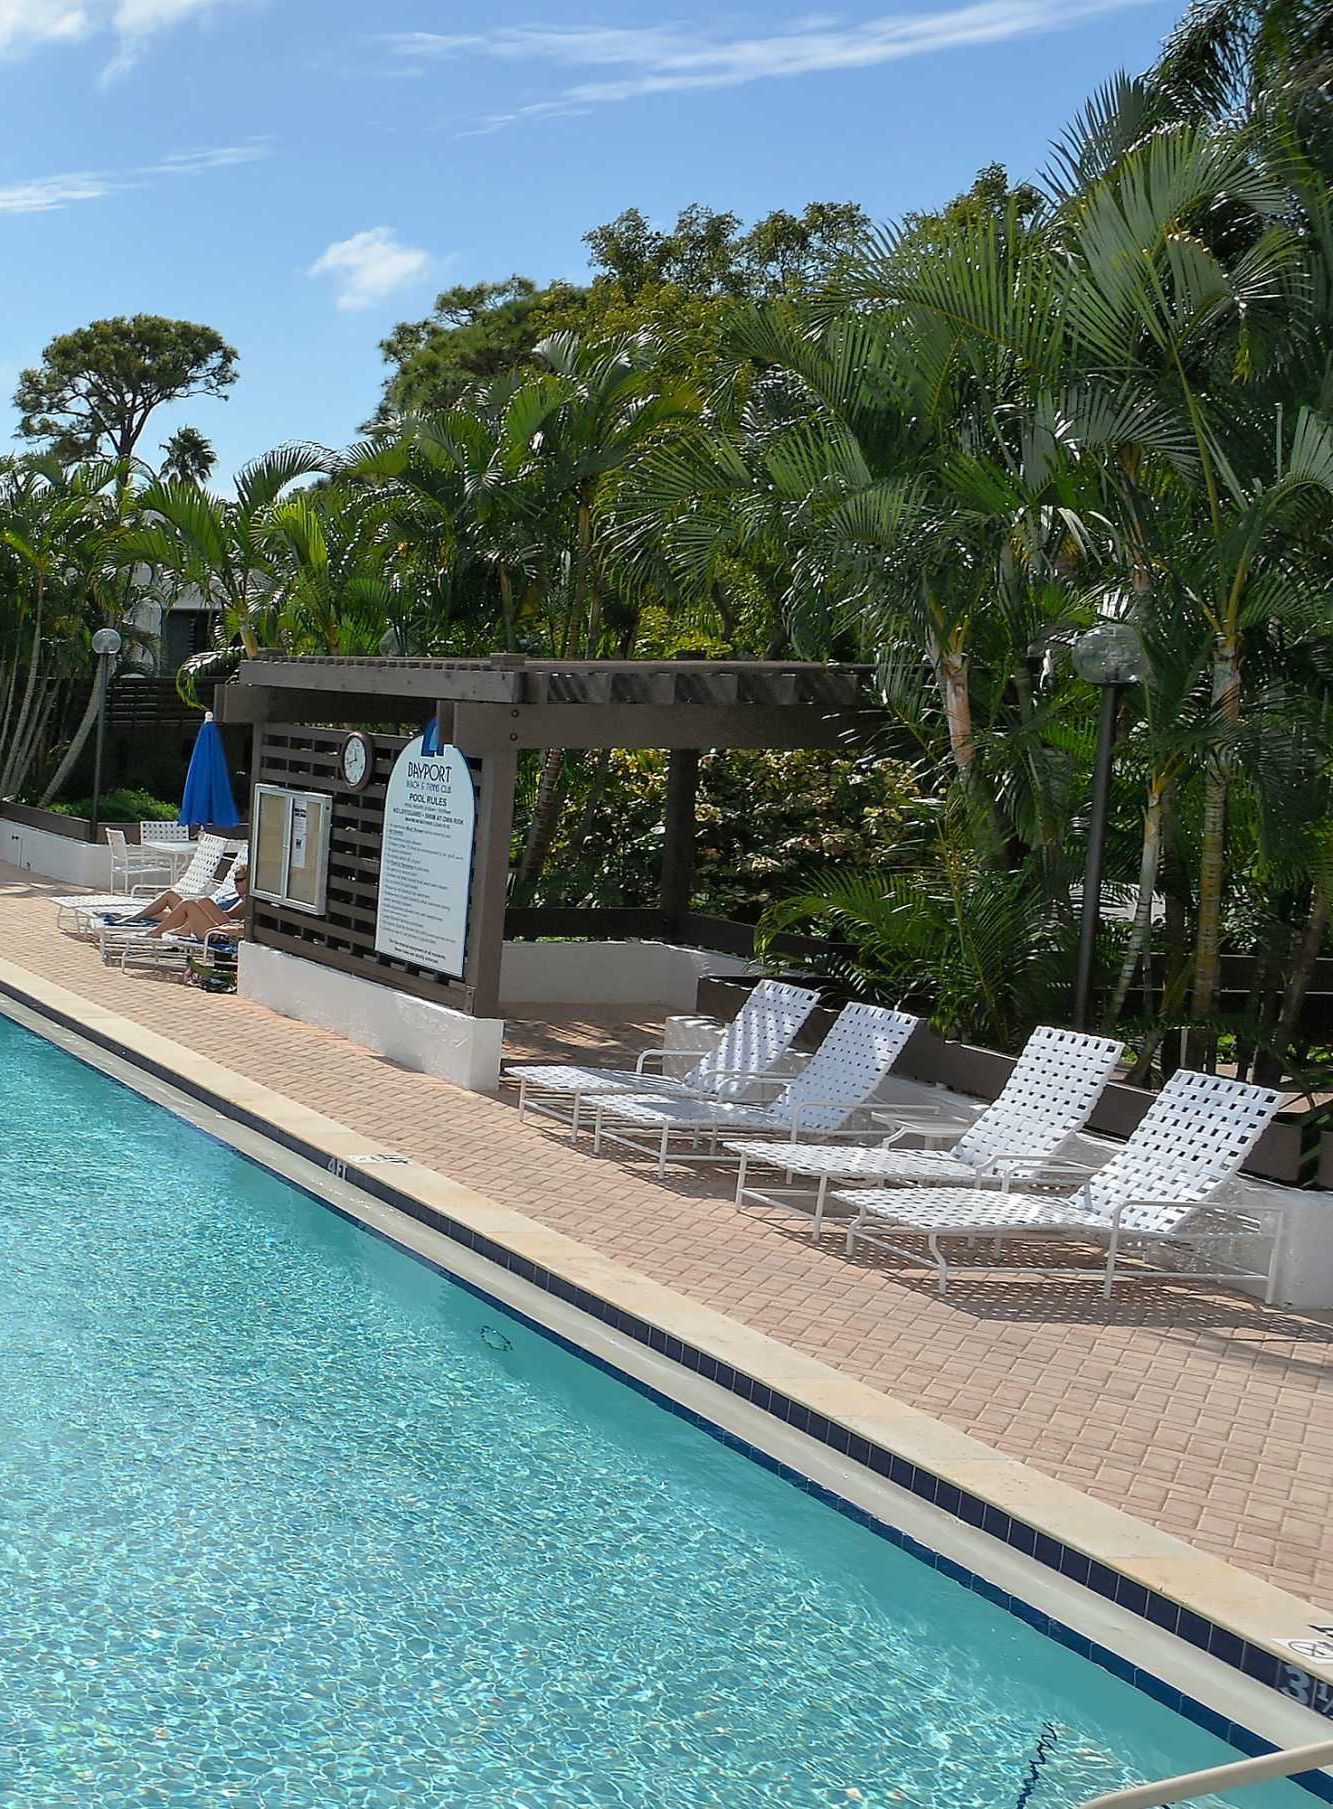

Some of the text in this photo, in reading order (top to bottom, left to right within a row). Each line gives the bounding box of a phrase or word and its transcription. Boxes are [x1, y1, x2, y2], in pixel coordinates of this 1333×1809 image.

[408, 761, 453, 783] BAYPORT
[409, 793, 447, 807] POOL RULES
